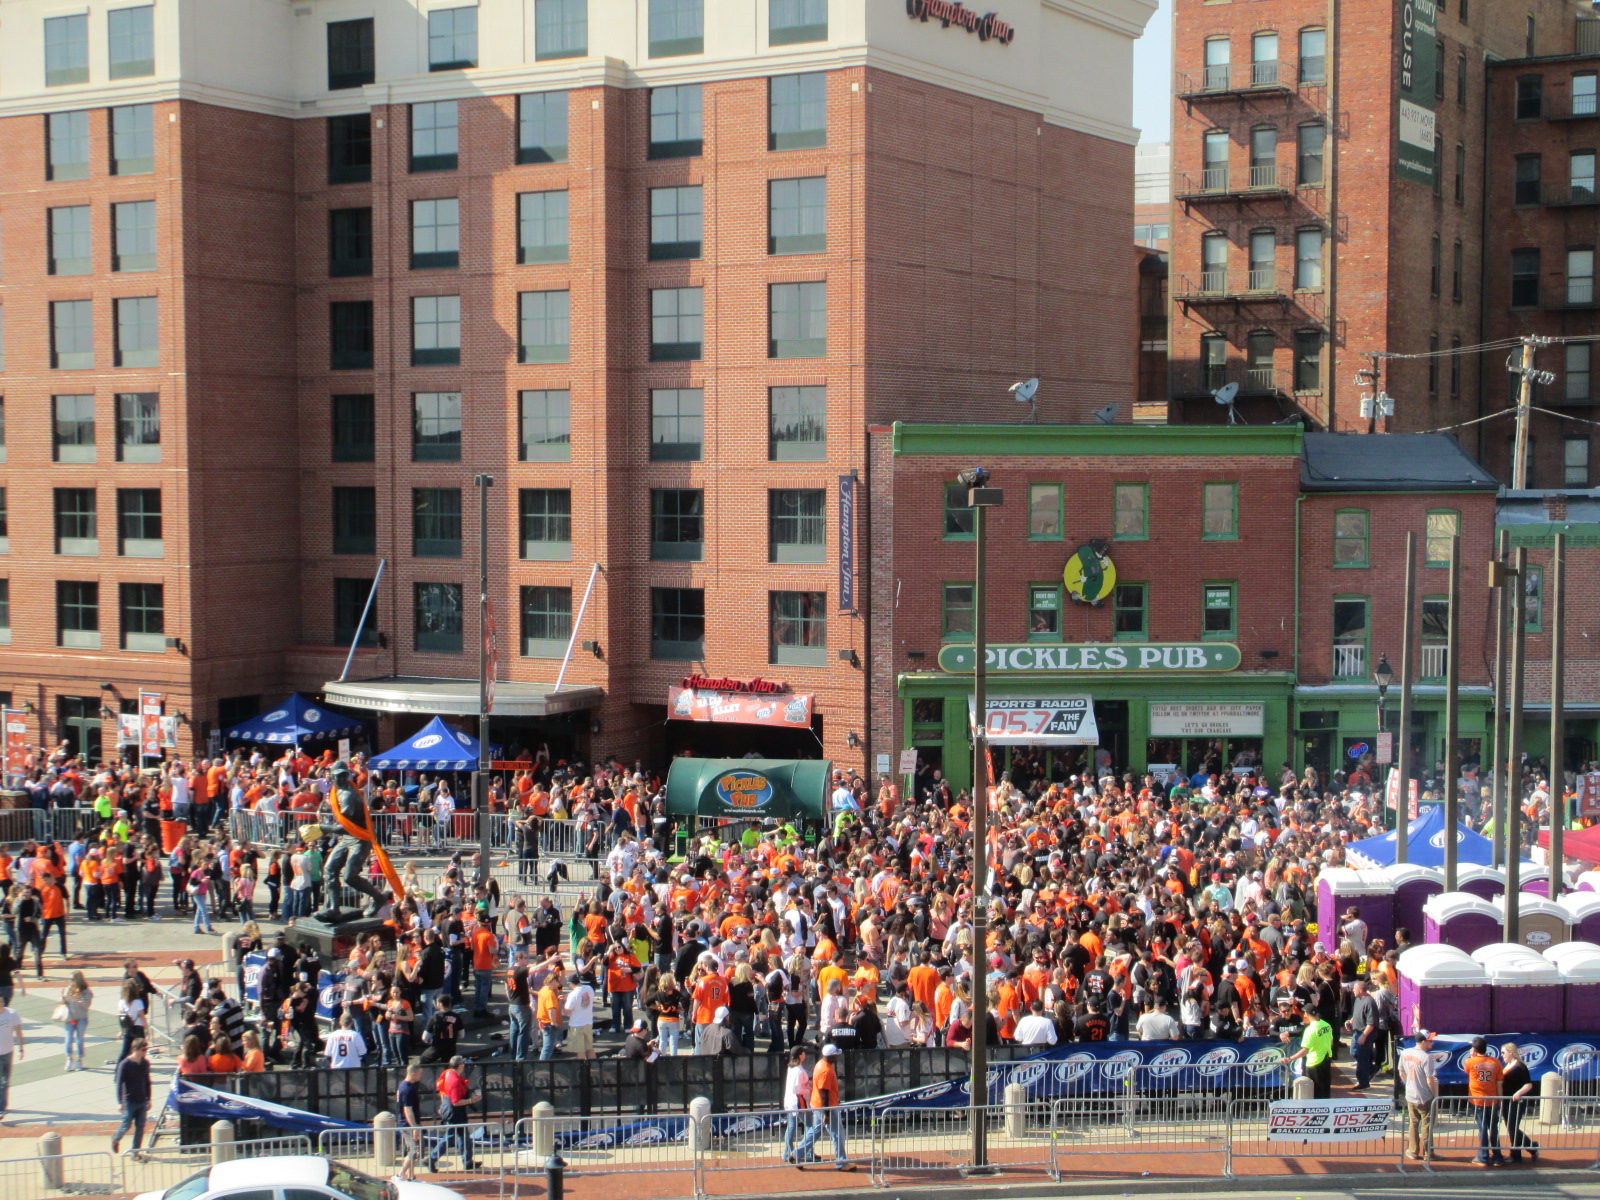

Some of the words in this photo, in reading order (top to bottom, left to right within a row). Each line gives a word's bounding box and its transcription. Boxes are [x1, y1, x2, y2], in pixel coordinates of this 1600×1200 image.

[982, 12, 1014, 43] Inn
[1402, 0, 1413, 88] OUSE
[840, 481, 852, 559] Hampton
[842, 562, 852, 602] Inn
[973, 647, 1129, 670] PICKLES
[1138, 647, 1208, 669] PUB
[682, 674, 743, 692] Hampton
[747, 677, 778, 693] Inn
[985, 700, 1035, 708] SPORTS
[1040, 700, 1084, 708] RADIO
[985, 711, 1051, 735] 05.7
[1050, 721, 1077, 731] FAN
[831, 1028, 857, 1037] SECURITY
[1091, 1028, 1103, 1041] 21
[339, 1043, 348, 1057] 8
[1157, 1055, 1184, 1075] Lite
[1204, 1055, 1232, 1074] Lite
[1252, 1055, 1278, 1074] Lite
[1477, 1070, 1493, 1082] 32
[1270, 1115, 1311, 1127] 105.7
[1333, 1114, 1372, 1126] 105.7
